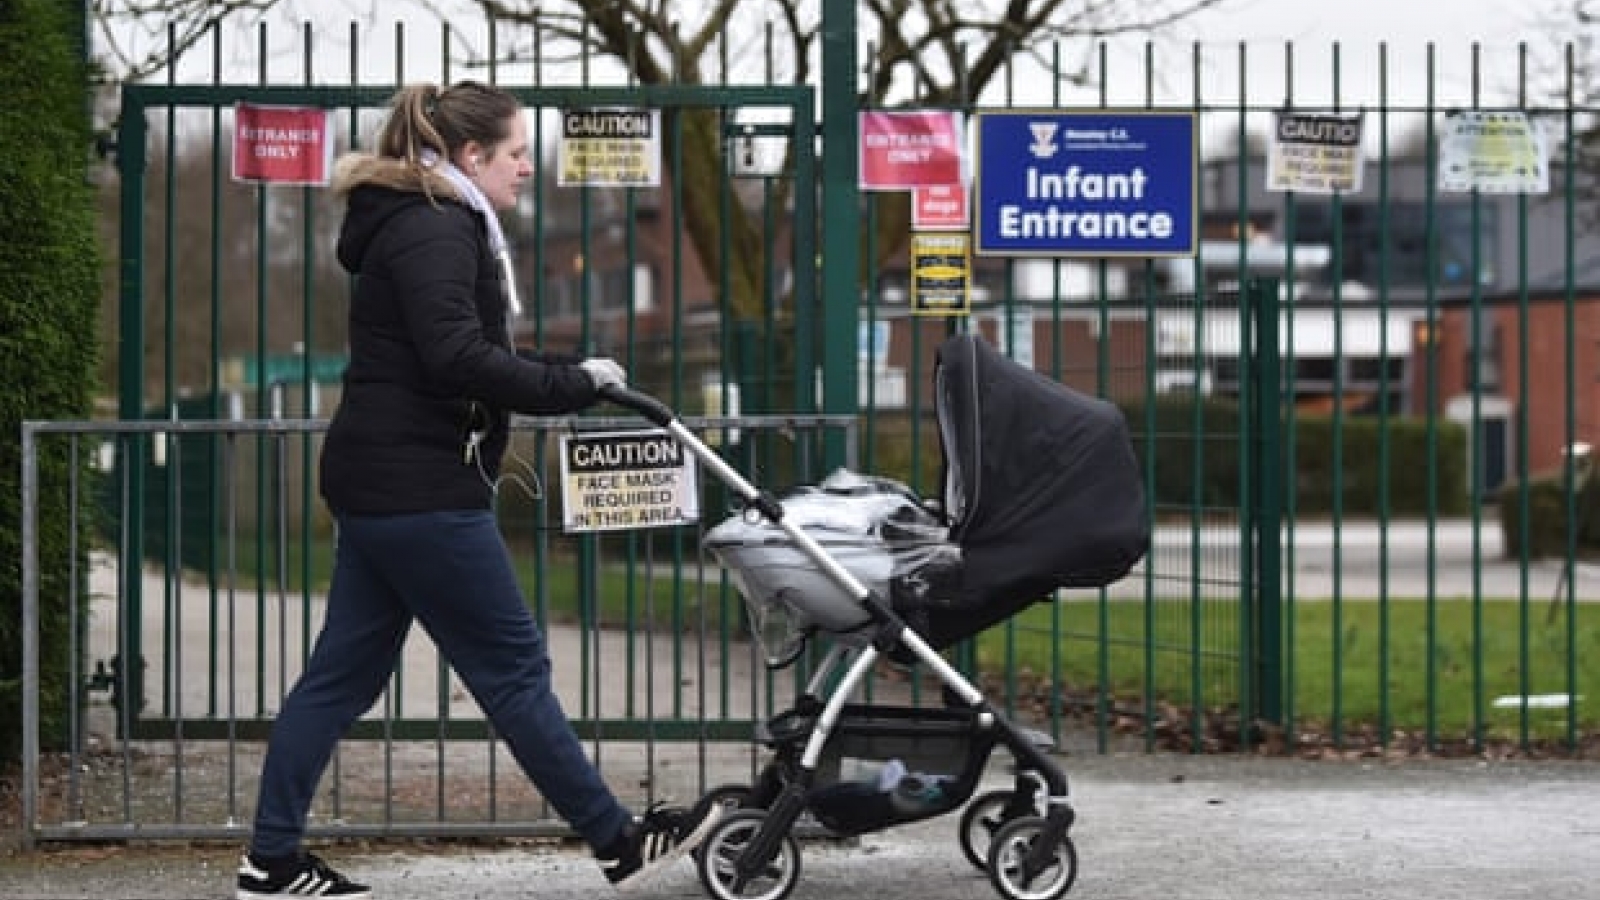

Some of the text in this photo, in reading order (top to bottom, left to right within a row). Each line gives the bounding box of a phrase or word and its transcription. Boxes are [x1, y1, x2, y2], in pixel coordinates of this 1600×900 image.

[567, 114, 647, 135] CAUTION
[1281, 120, 1357, 143] CAUTIO
[865, 133, 951, 147] ENTRANCE
[255, 145, 299, 159] ONLY
[887, 149, 931, 163] ONLY
[1027, 166, 1148, 200] Infant
[1000, 204, 1173, 239] Entrance
[573, 441, 678, 467] CAUTION
[577, 472, 673, 491] FACE MASK
[582, 491, 672, 507] REQUIRED
[595, 510, 634, 526] THIS
[639, 507, 684, 523] AREA
